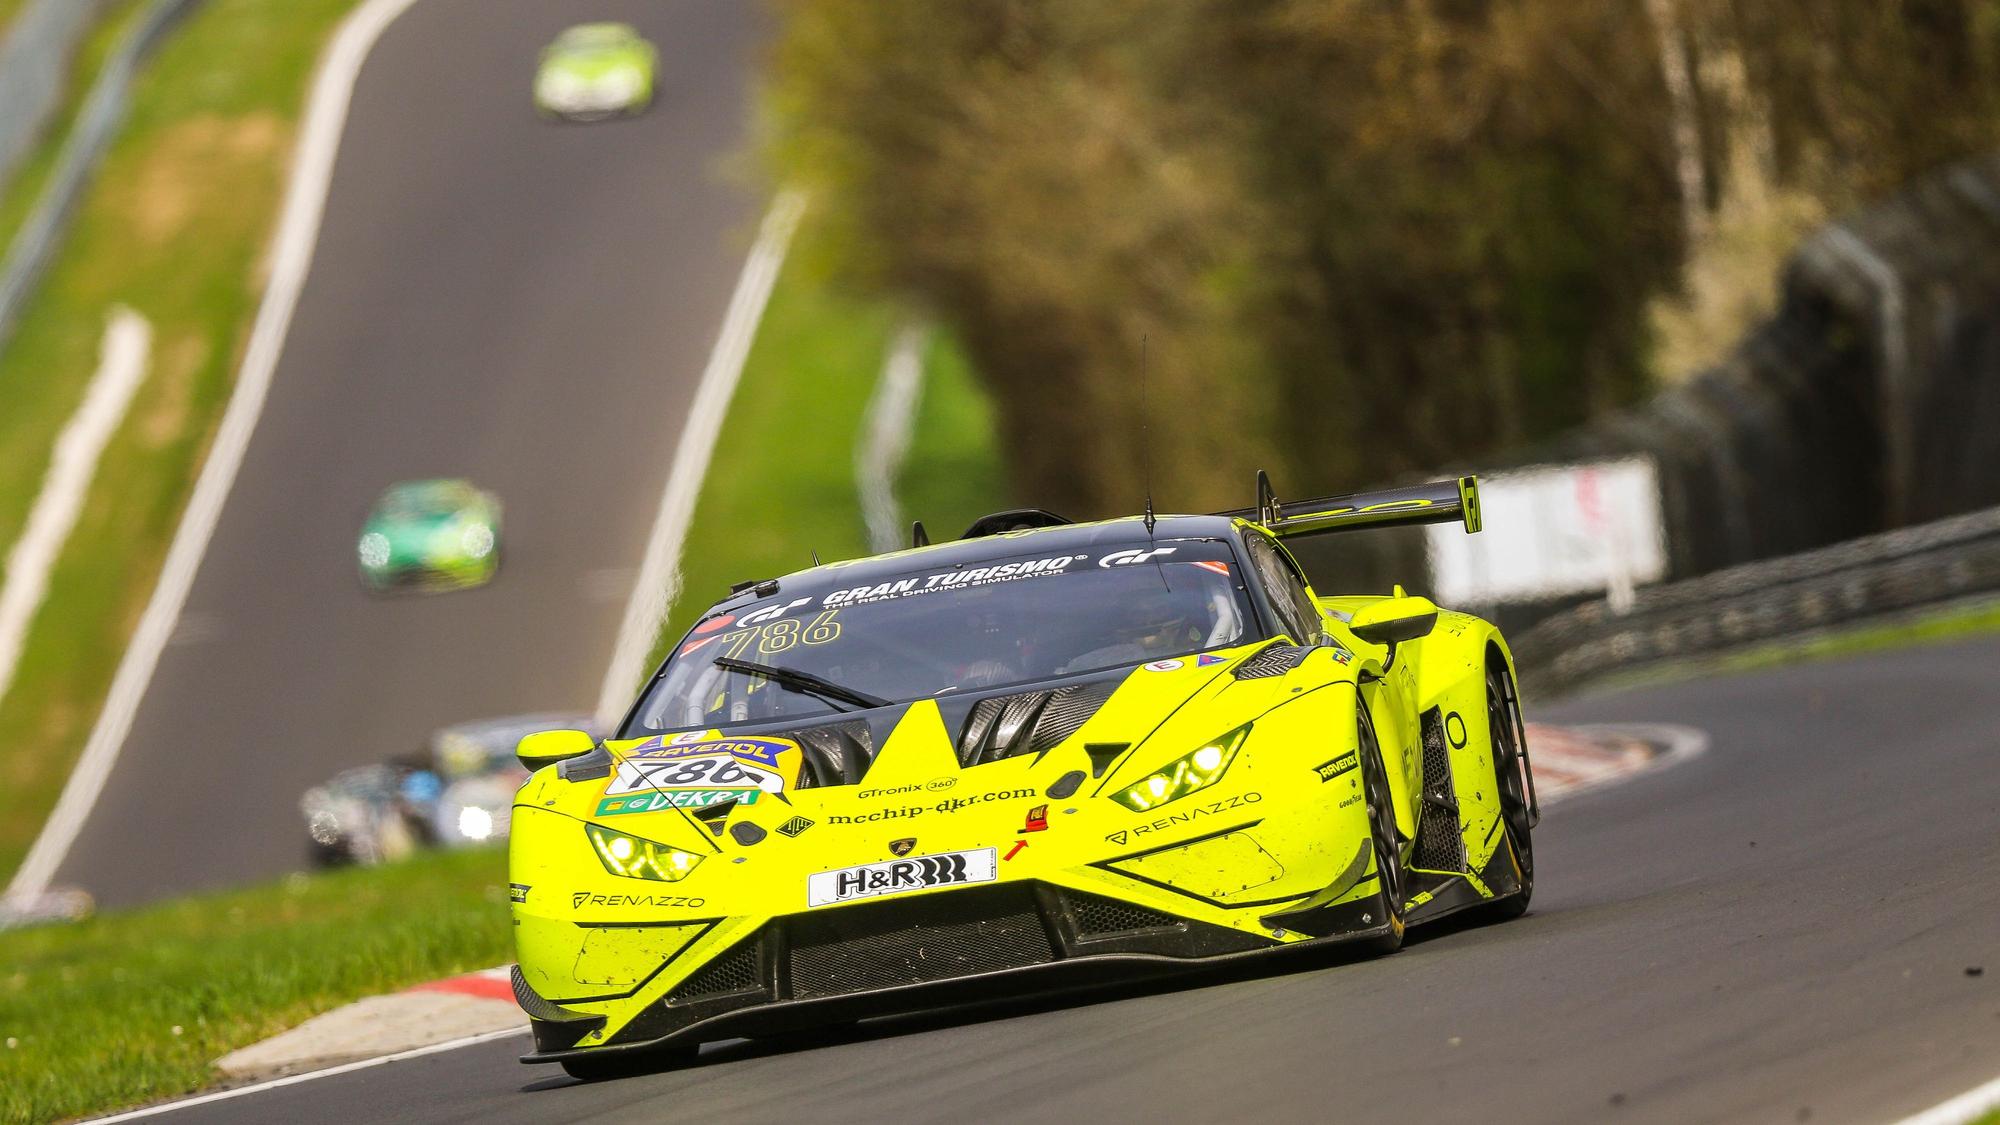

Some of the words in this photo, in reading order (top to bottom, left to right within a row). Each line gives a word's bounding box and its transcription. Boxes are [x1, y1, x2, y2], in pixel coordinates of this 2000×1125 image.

[822, 578, 919, 605] GRAN
[823, 600, 853, 610] THE
[857, 593, 899, 604] REAL
[902, 582, 968, 597] DRIVING
[971, 568, 1064, 587] SIMULATOR
[722, 610, 842, 660] 786
[642, 742, 770, 759] RAVENOL
[627, 759, 765, 790] 786
[646, 790, 752, 811] DEKRA
[827, 787, 1037, 825] mcchip-dkr.com
[1132, 791, 1263, 837] RENAZZO
[838, 861, 916, 896] H&R
[589, 894, 706, 909] RENAZZO
